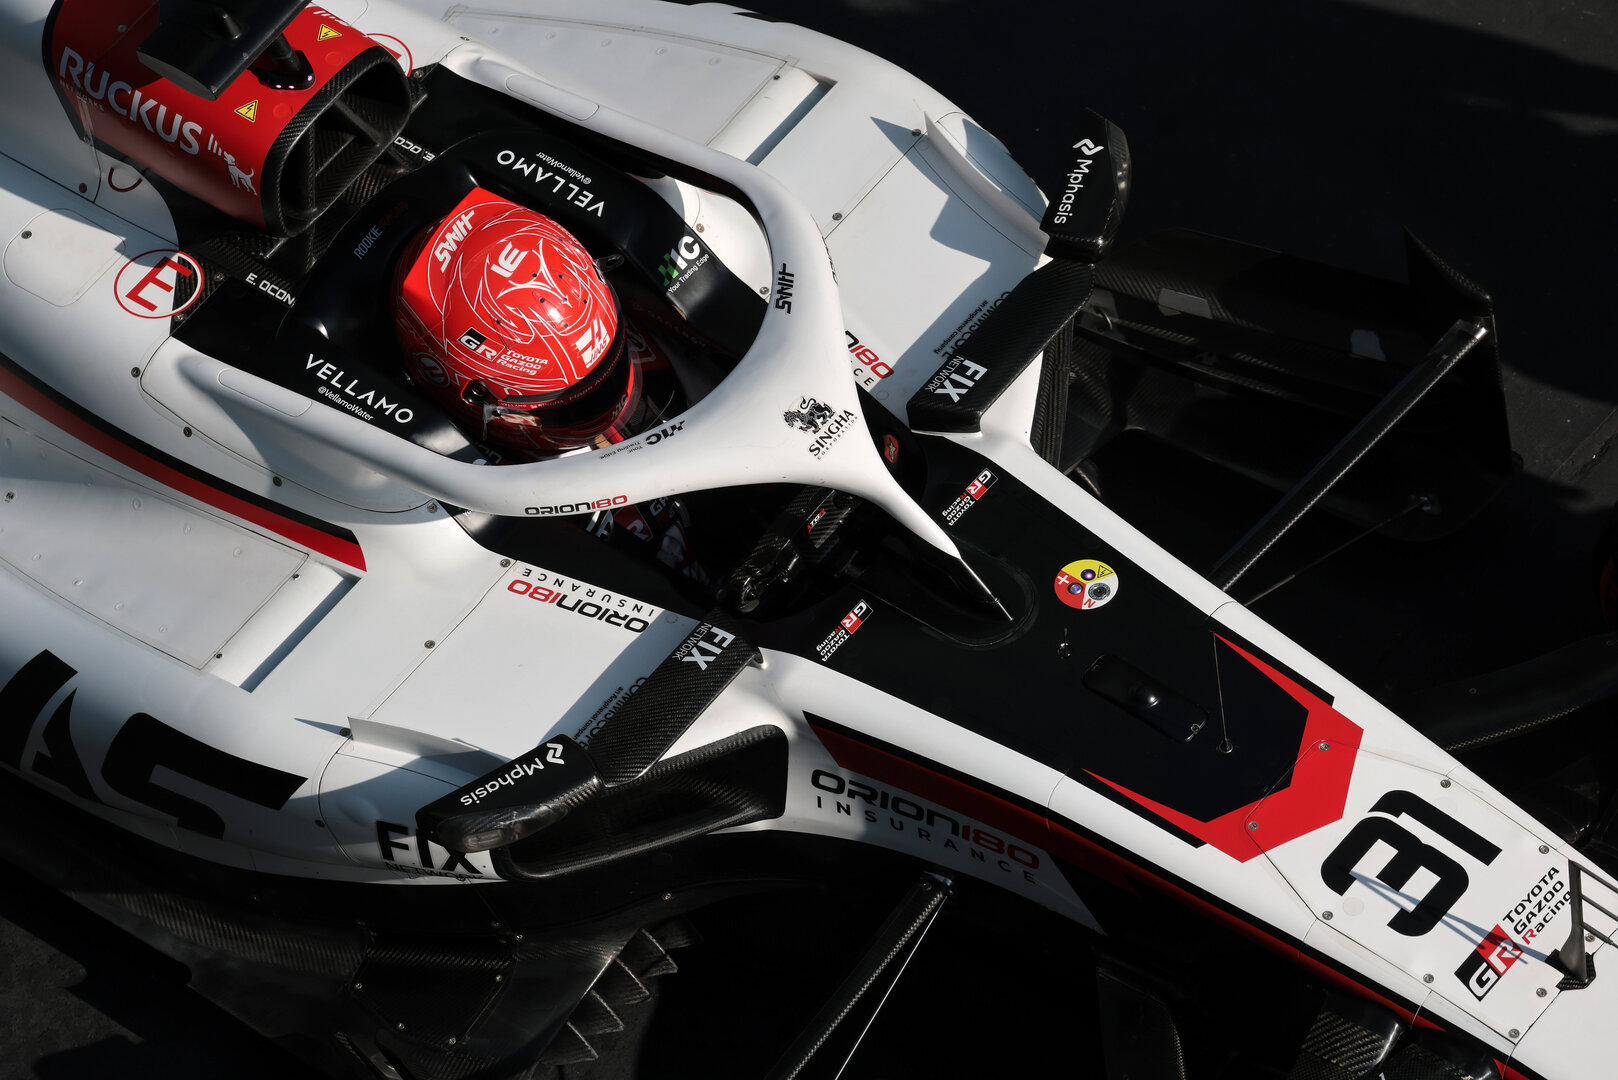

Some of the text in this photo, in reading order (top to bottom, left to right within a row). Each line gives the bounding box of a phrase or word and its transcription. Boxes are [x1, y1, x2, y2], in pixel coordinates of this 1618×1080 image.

[59, 46, 204, 156] RUCKUS
[394, 136, 435, 162] E. OCO
[497, 150, 605, 217] VELLAMO
[536, 152, 592, 185] @VellamoWater
[1054, 158, 1093, 225] Mphasis
[353, 224, 383, 260] ROOKIE
[245, 272, 296, 305] E. OCON
[668, 254, 709, 293] Your Trading Edge
[460, 335, 497, 360] GR
[500, 354, 541, 370] GAZOO
[506, 349, 548, 365] TOYOTA
[845, 330, 895, 379] N180
[933, 331, 958, 355] company
[496, 359, 538, 375] Racing
[925, 355, 965, 393] NETWORK
[933, 359, 988, 403] FIX
[305, 353, 414, 423] VELLAMO
[318, 385, 374, 421] @VellamoWater
[809, 409, 854, 457] SINGHA
[967, 470, 992, 494] GR
[942, 492, 967, 517] Racing
[946, 495, 971, 521] GAZOO
[948, 500, 975, 526] TOYOTA
[507, 578, 649, 633] ORION180
[522, 568, 655, 617] INSURANCE
[843, 601, 867, 628] GR
[672, 622, 712, 660] NETWORK
[681, 626, 736, 671] FIX
[816, 625, 842, 651] Racing
[820, 629, 845, 656] GAZOO
[822, 634, 850, 661] TOYOTA
[572, 718, 593, 741] compan
[460, 757, 544, 806] Mphasis
[811, 769, 1040, 870] ORION180
[376, 820, 483, 875] FIX
[817, 796, 1036, 884] INSURANCE
[1321, 789, 1503, 936] 31
[1502, 866, 1560, 924] TOYOTA
[1513, 880, 1565, 935] GAZOO
[1522, 891, 1573, 945] Racing
[1468, 939, 1524, 998] GR
